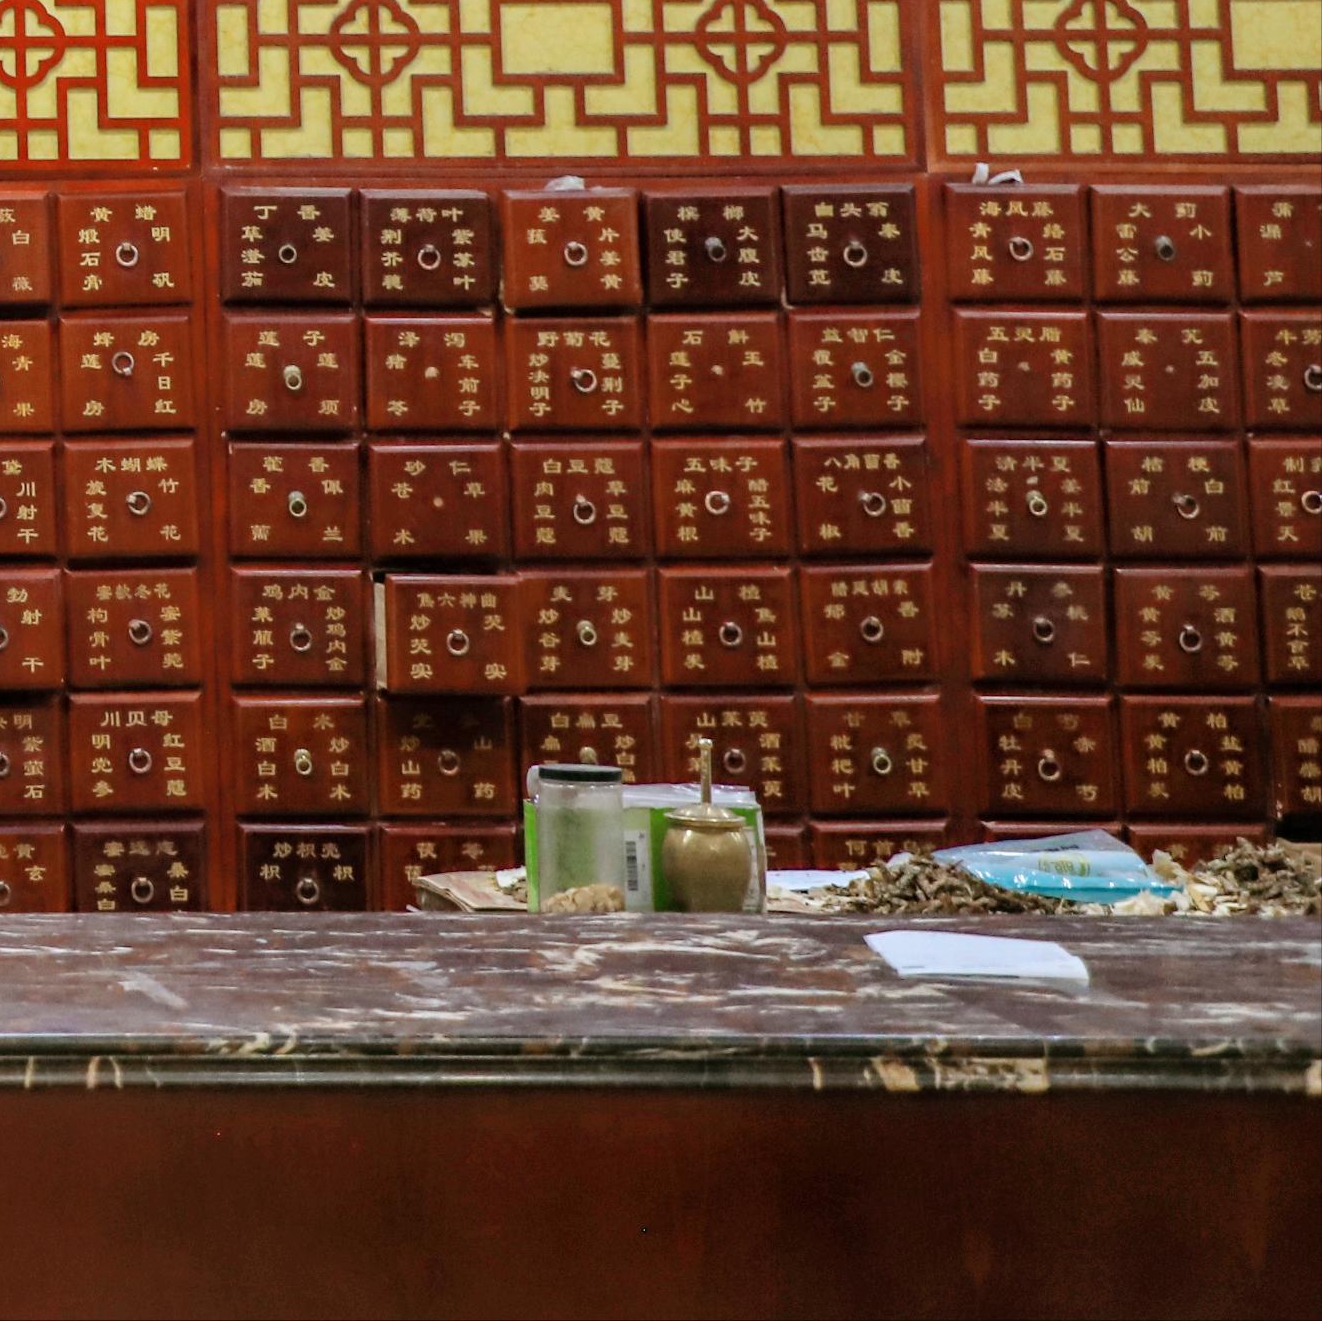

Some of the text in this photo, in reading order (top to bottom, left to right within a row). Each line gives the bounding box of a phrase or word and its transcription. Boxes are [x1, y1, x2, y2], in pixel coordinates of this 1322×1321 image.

[737, 226, 760, 286] 大腹皮
[12, 356, 34, 417] 青果
[153, 352, 176, 413] 千日红
[978, 348, 1000, 410] 白药子
[1051, 349, 1074, 410] 黄药子
[1122, 351, 1144, 412] 威灵仙
[1196, 351, 1219, 413] 五加皮
[95, 457, 167, 473] 木蝴蝶
[684, 457, 757, 472] 五味子
[17, 482, 38, 543] 川射干
[675, 479, 698, 541] 麻黄根
[889, 476, 914, 537] 小茴香
[262, 584, 335, 600] 鸡内金
[21, 609, 43, 672] 射干
[87, 608, 111, 670] 枸骨叶
[252, 607, 274, 669] 莱菔子
[326, 607, 347, 670] 炒鸡内金
[410, 615, 433, 679] 炒芡实
[101, 711, 173, 726] 川贝母
[92, 735, 113, 797] 明党参
[163, 733, 186, 796] 红豆蔻
